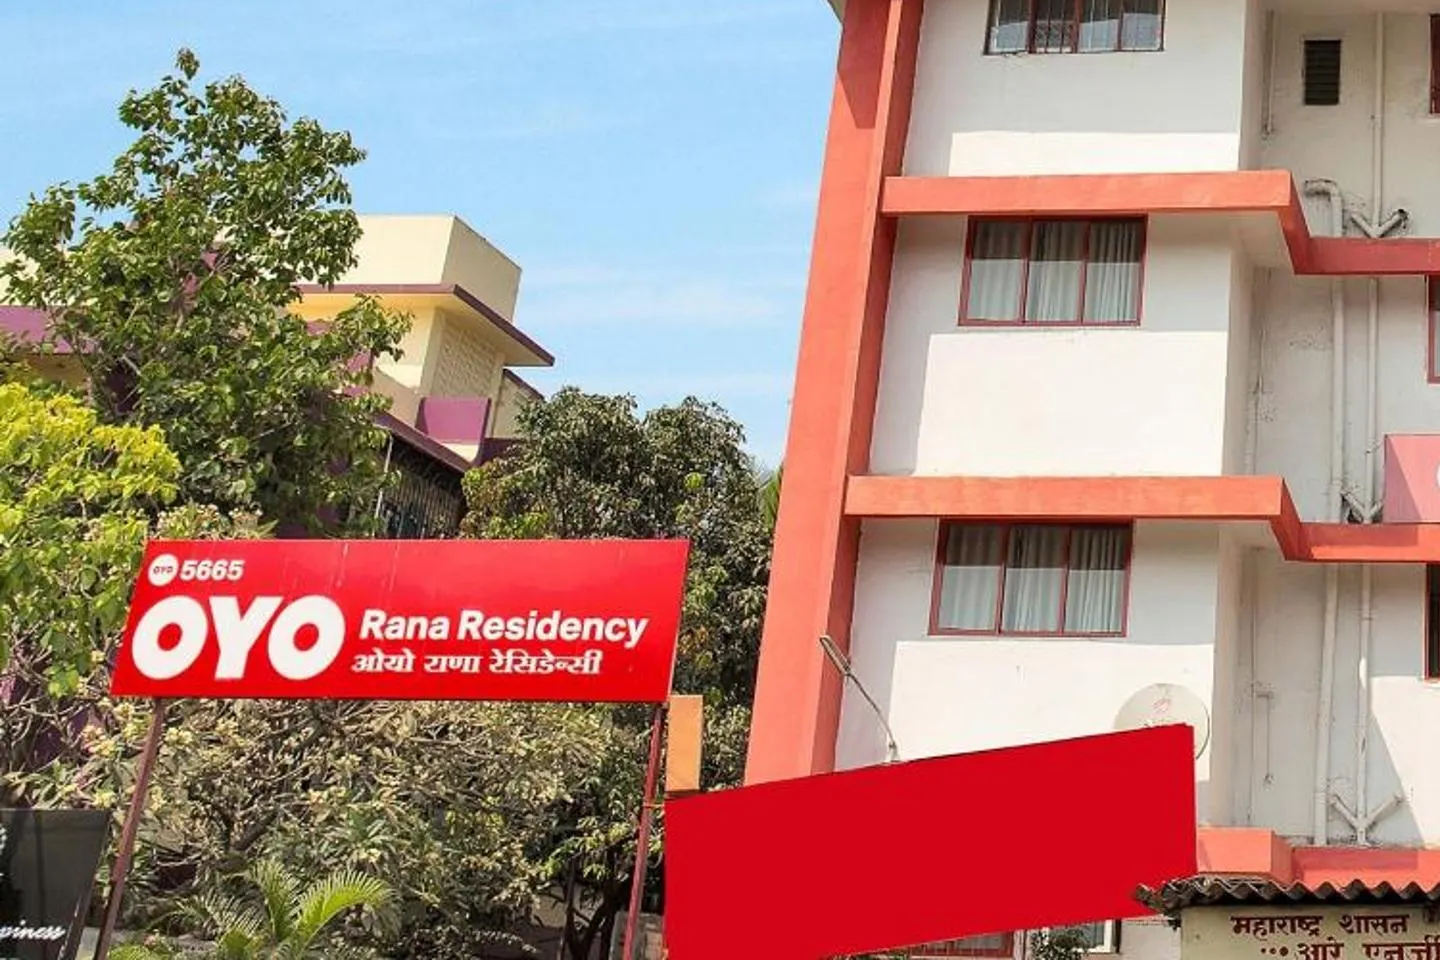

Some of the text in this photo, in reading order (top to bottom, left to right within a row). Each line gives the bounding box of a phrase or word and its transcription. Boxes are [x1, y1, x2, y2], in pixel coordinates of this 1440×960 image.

[180, 559, 245, 581] 5665
[132, 595, 345, 680] OYO
[359, 609, 648, 648] Rana Residency
[351, 647, 603, 675] ओयो राणा रेसिडेन्सी
[1231, 915, 1323, 941] महाराष्ट्र
[1339, 914, 1410, 936] शासन
